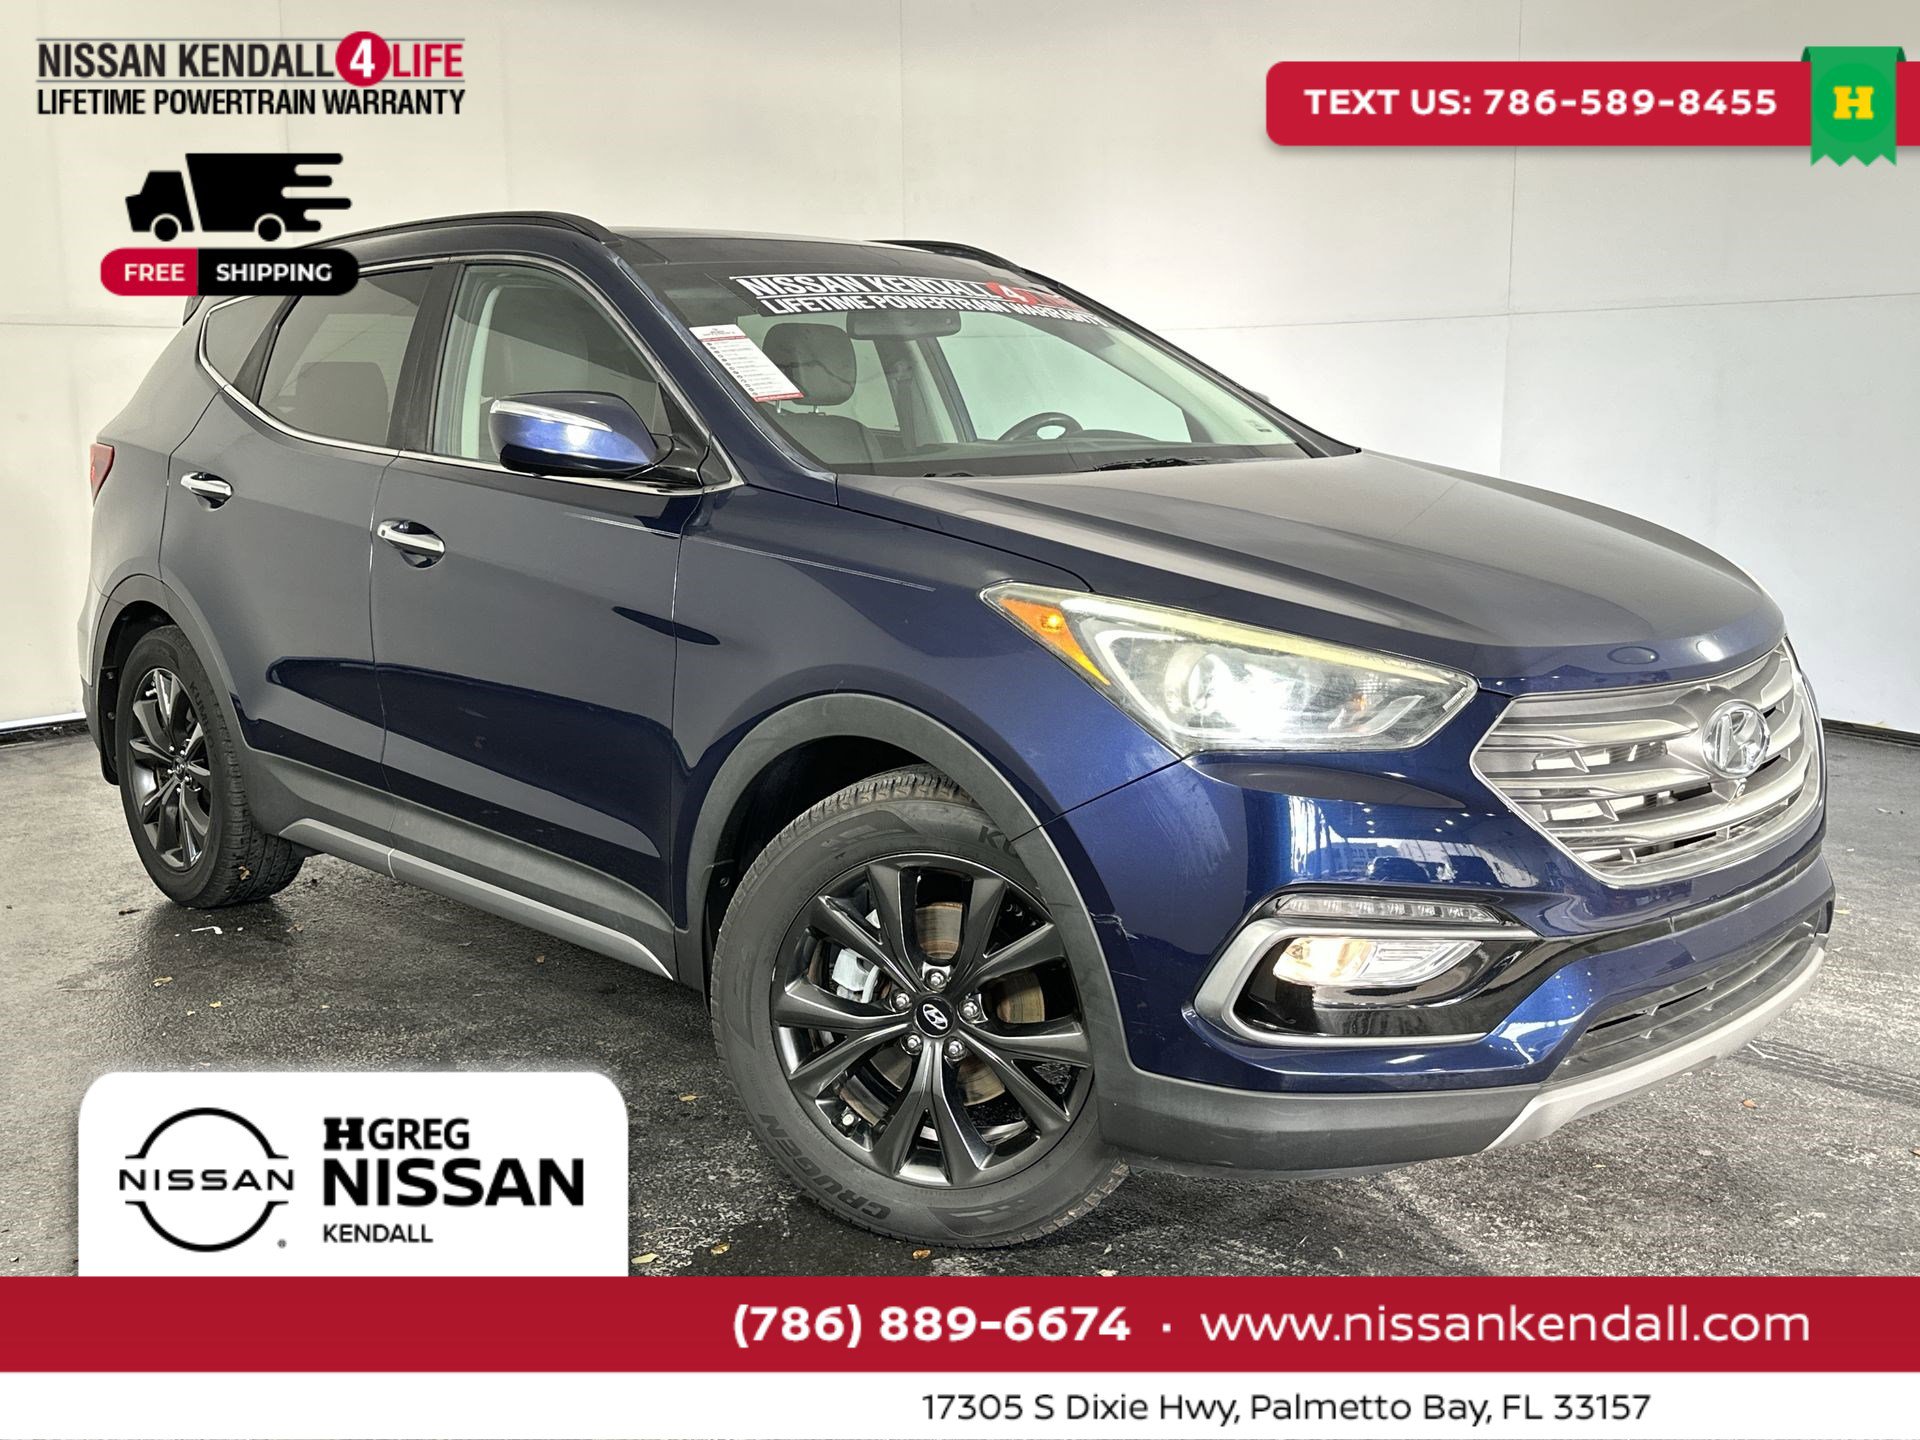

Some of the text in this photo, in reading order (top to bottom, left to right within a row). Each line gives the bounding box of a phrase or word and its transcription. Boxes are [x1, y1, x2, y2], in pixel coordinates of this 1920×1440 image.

[736, 275, 866, 297] NISSAN
[863, 275, 1003, 298] KENDALL
[761, 295, 876, 315] LIFETIME
[864, 294, 1012, 314] POWERTRAIN
